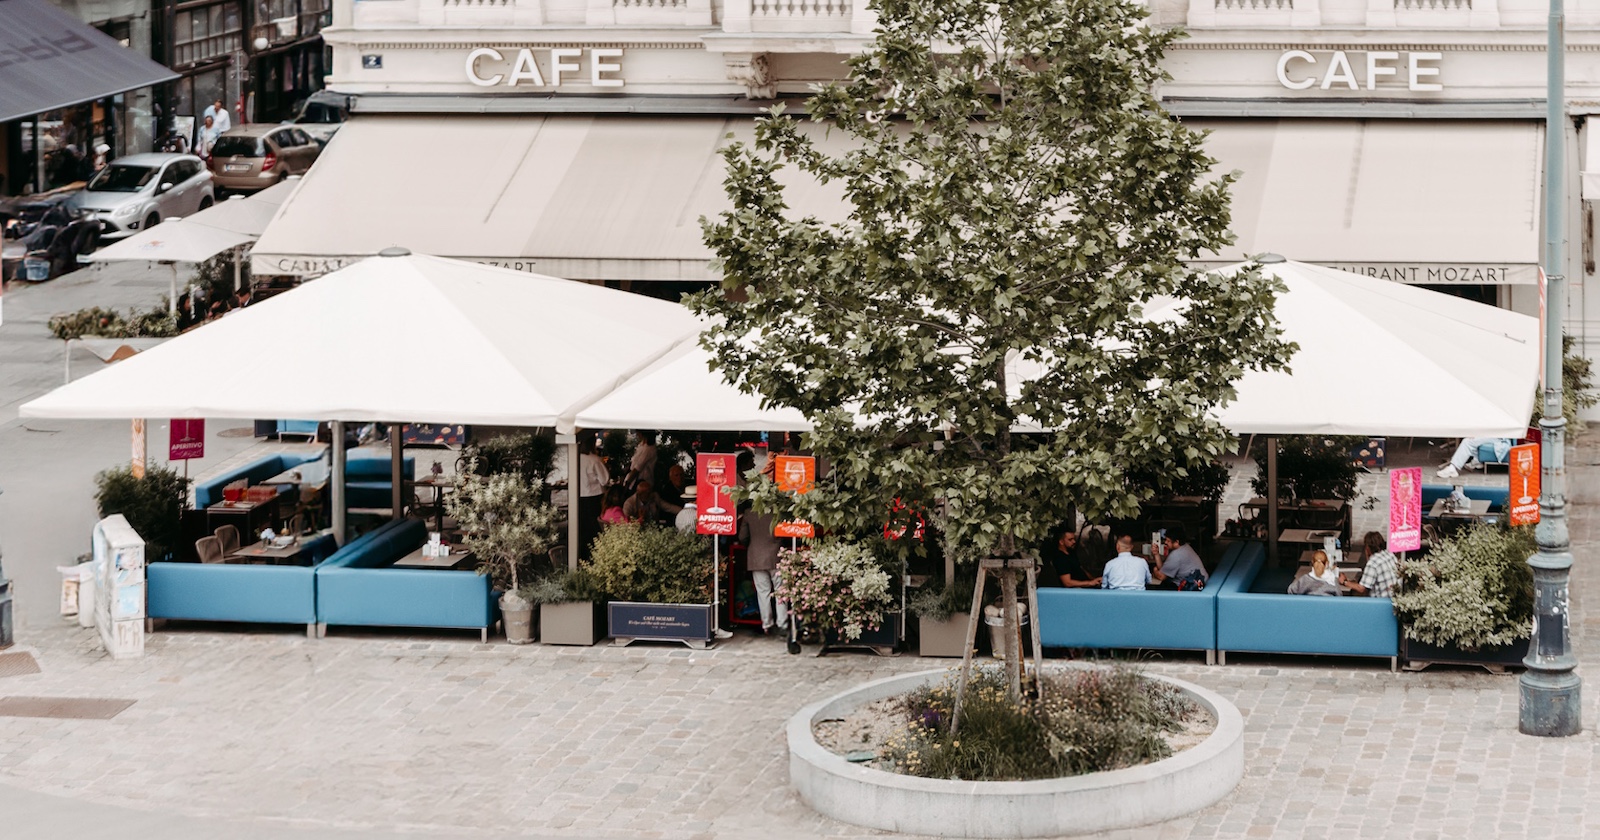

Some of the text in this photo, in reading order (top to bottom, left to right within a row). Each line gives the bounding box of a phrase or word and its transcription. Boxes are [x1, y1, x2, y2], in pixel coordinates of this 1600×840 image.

[465, 47, 625, 87] CAFE
[1276, 50, 1443, 91] CAFE
[1427, 267, 1510, 282] MOZART
[171, 442, 203, 451] APERITIVO
[698, 514, 734, 523] APERITIVO
[1391, 530, 1418, 540] APERITIVO
